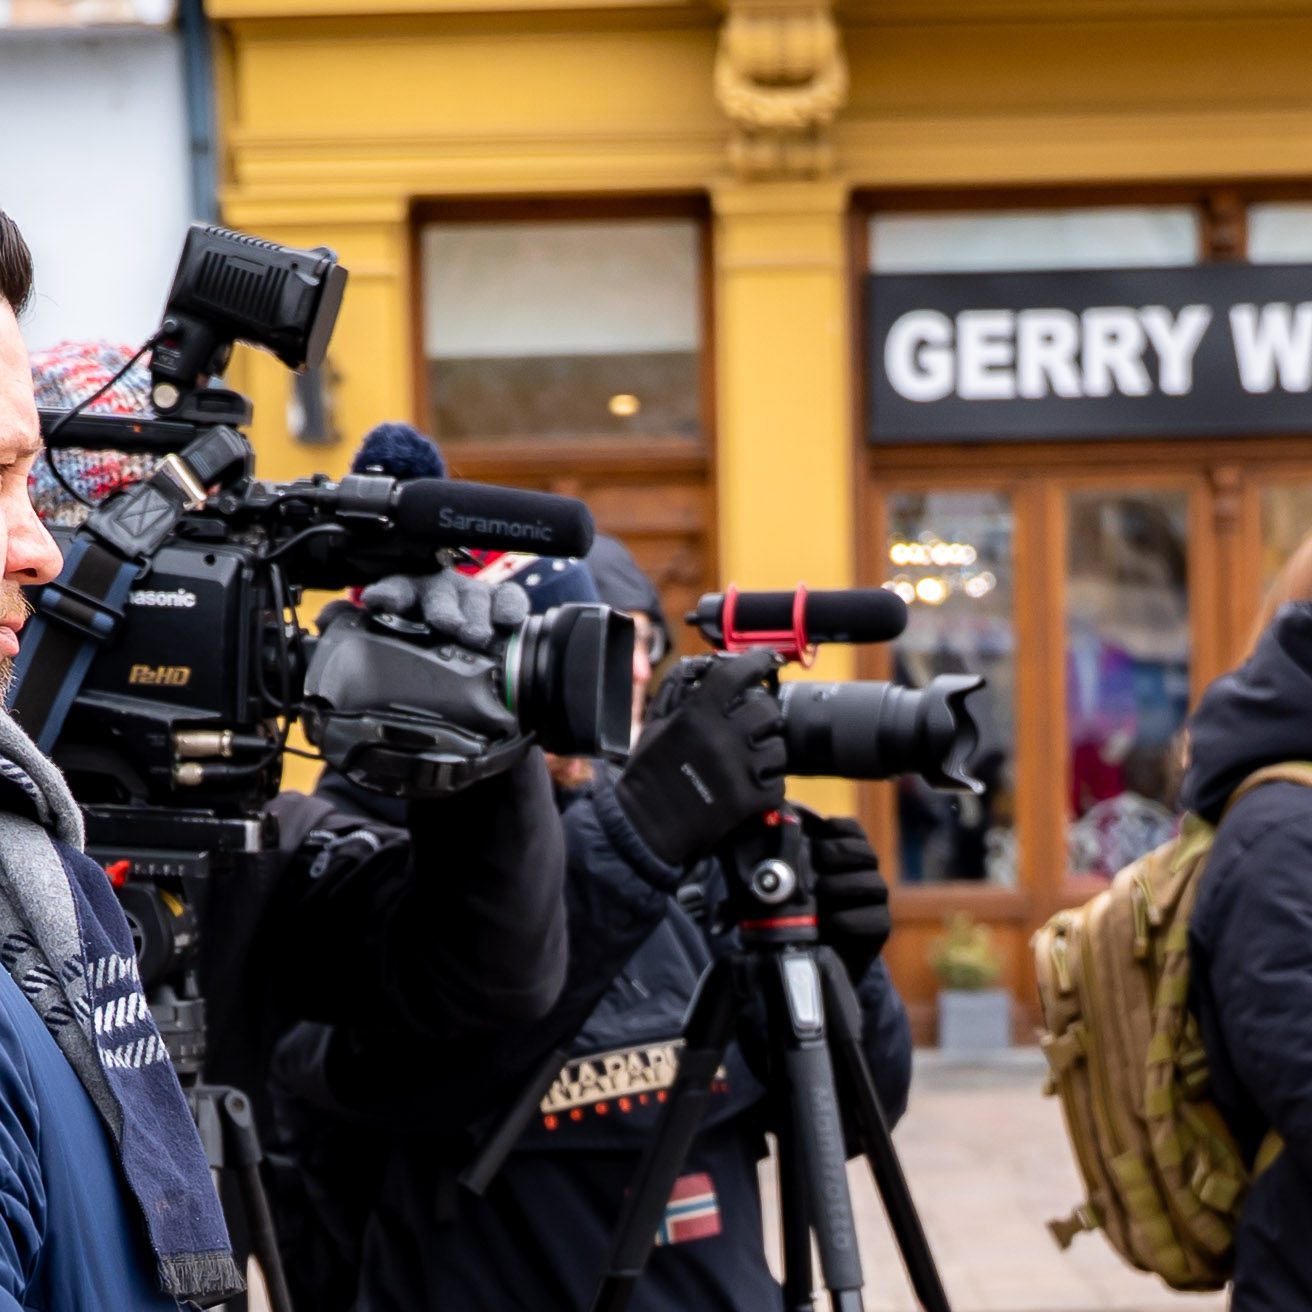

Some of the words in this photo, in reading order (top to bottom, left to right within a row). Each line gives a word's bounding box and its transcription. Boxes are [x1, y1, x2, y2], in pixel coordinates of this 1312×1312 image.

[884, 304, 1212, 401] GERRY
[438, 507, 553, 541] Saramonic
[129, 664, 192, 686] P2HD
